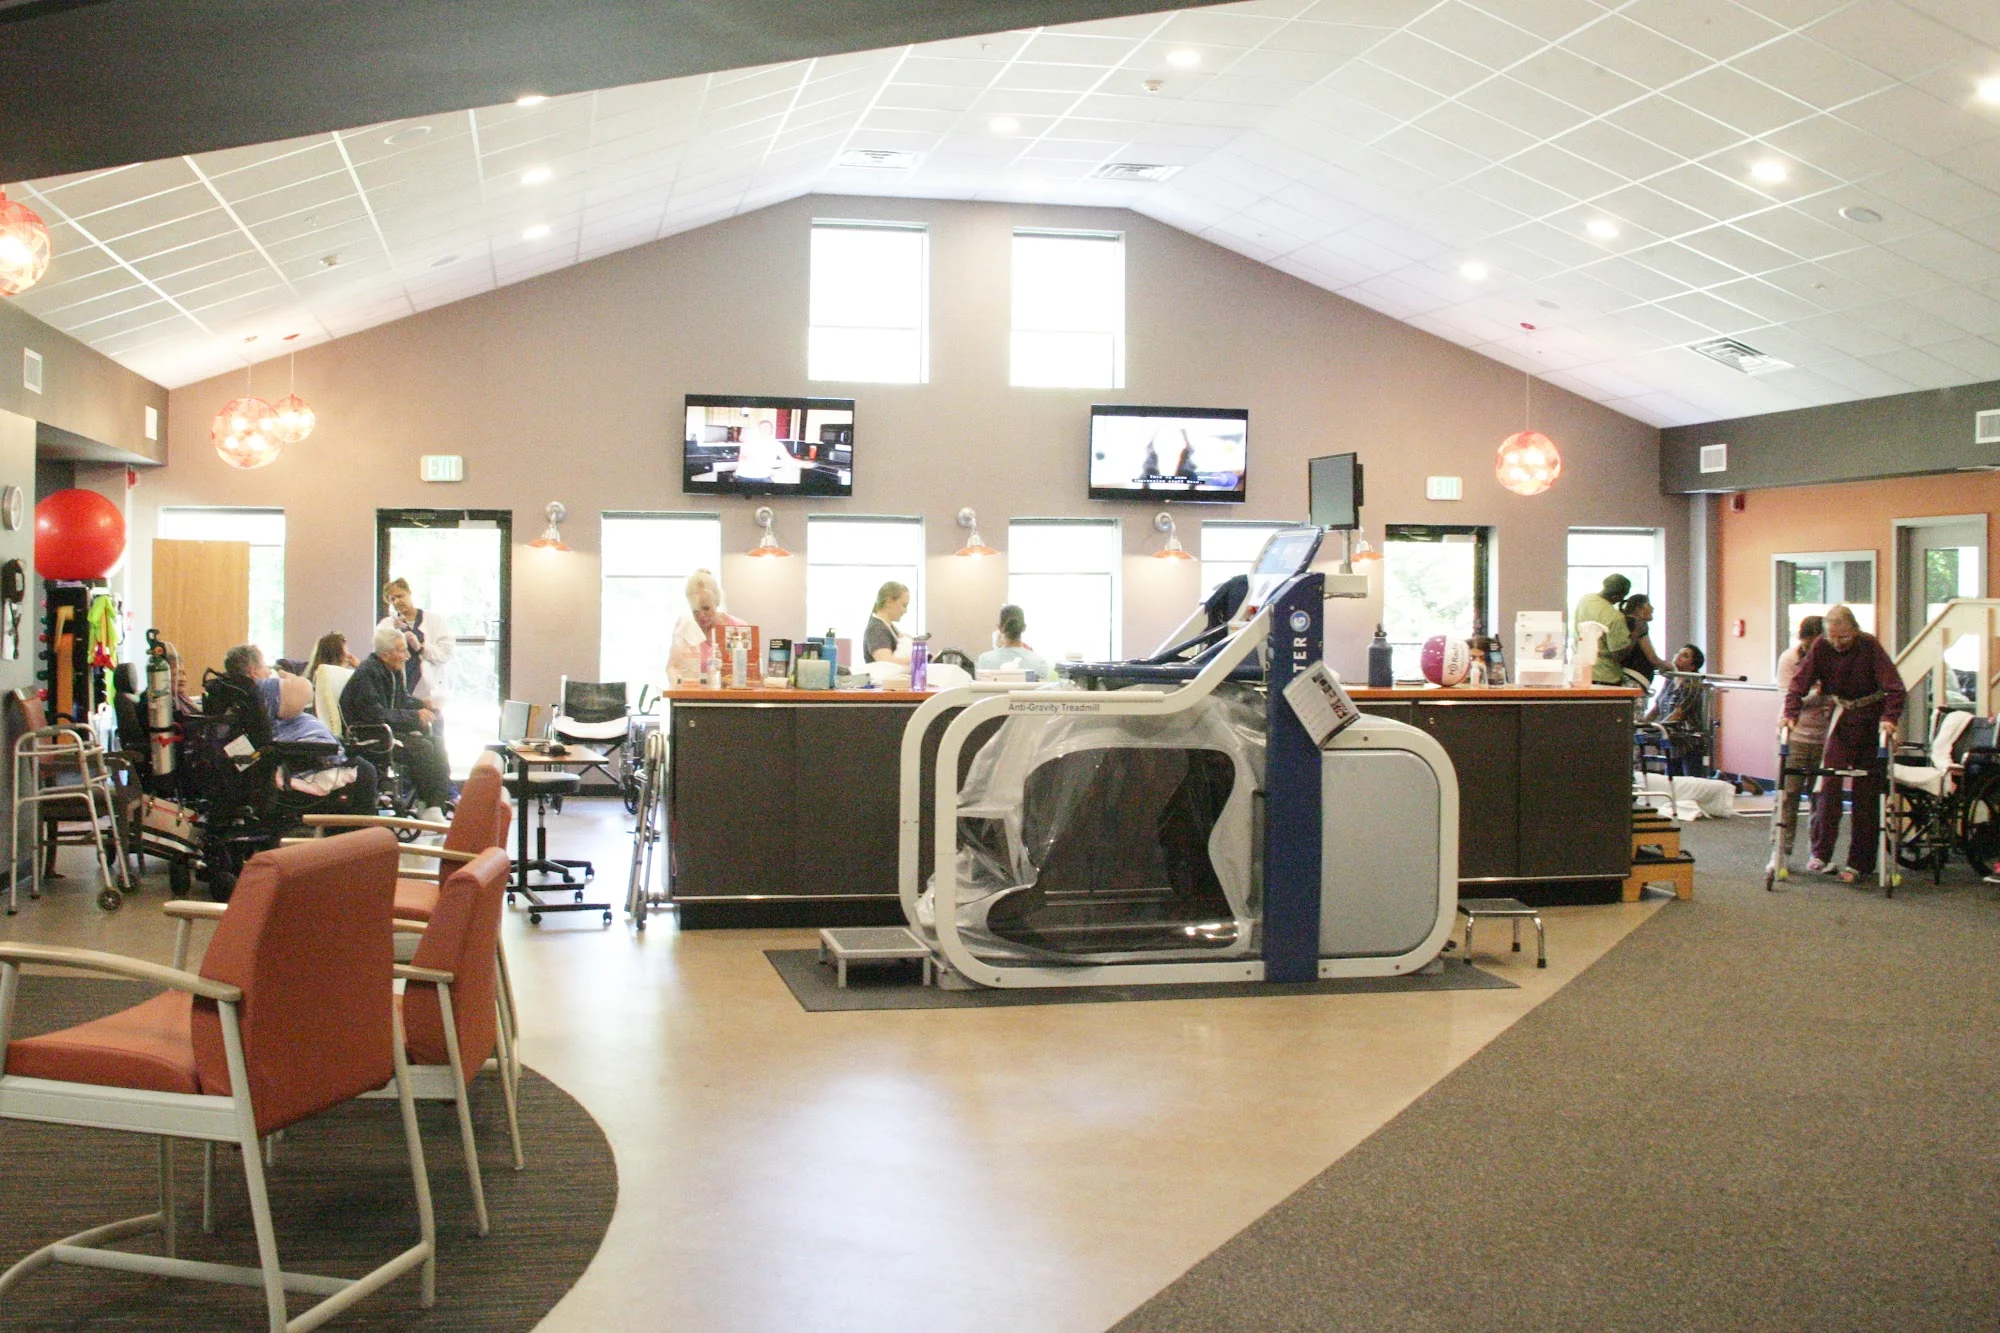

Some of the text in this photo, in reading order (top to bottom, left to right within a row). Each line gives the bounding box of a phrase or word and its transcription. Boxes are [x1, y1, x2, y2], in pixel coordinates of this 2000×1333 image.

[427, 456, 457, 479] EXIT
[1293, 637, 1307, 680] TER
[1008, 703, 1100, 713] Anti-Gravity Treadmill
